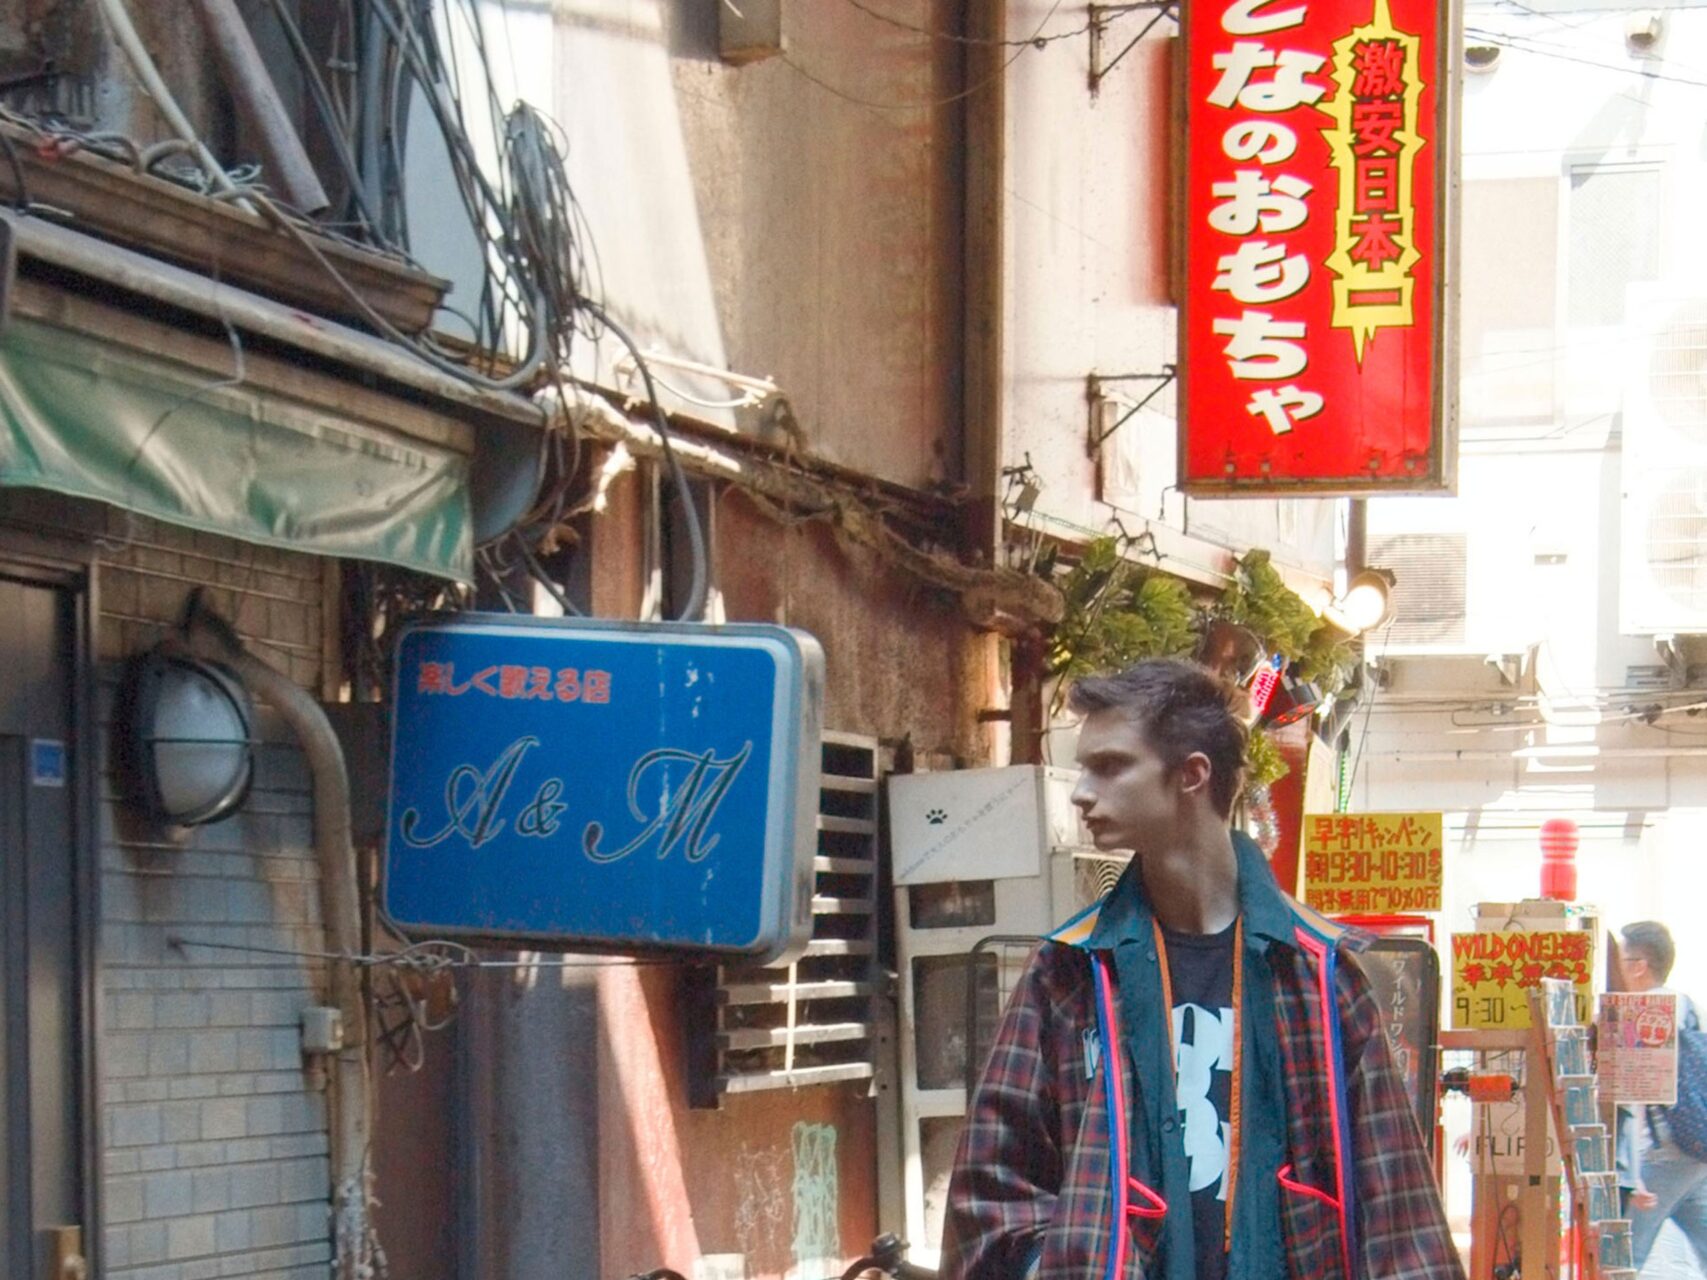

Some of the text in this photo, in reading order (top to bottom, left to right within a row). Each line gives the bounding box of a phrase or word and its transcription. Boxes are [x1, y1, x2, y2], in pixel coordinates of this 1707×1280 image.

[1348, 38, 1405, 307] 激安日本一
[403, 736, 541, 849] A
[515, 778, 568, 838] &
